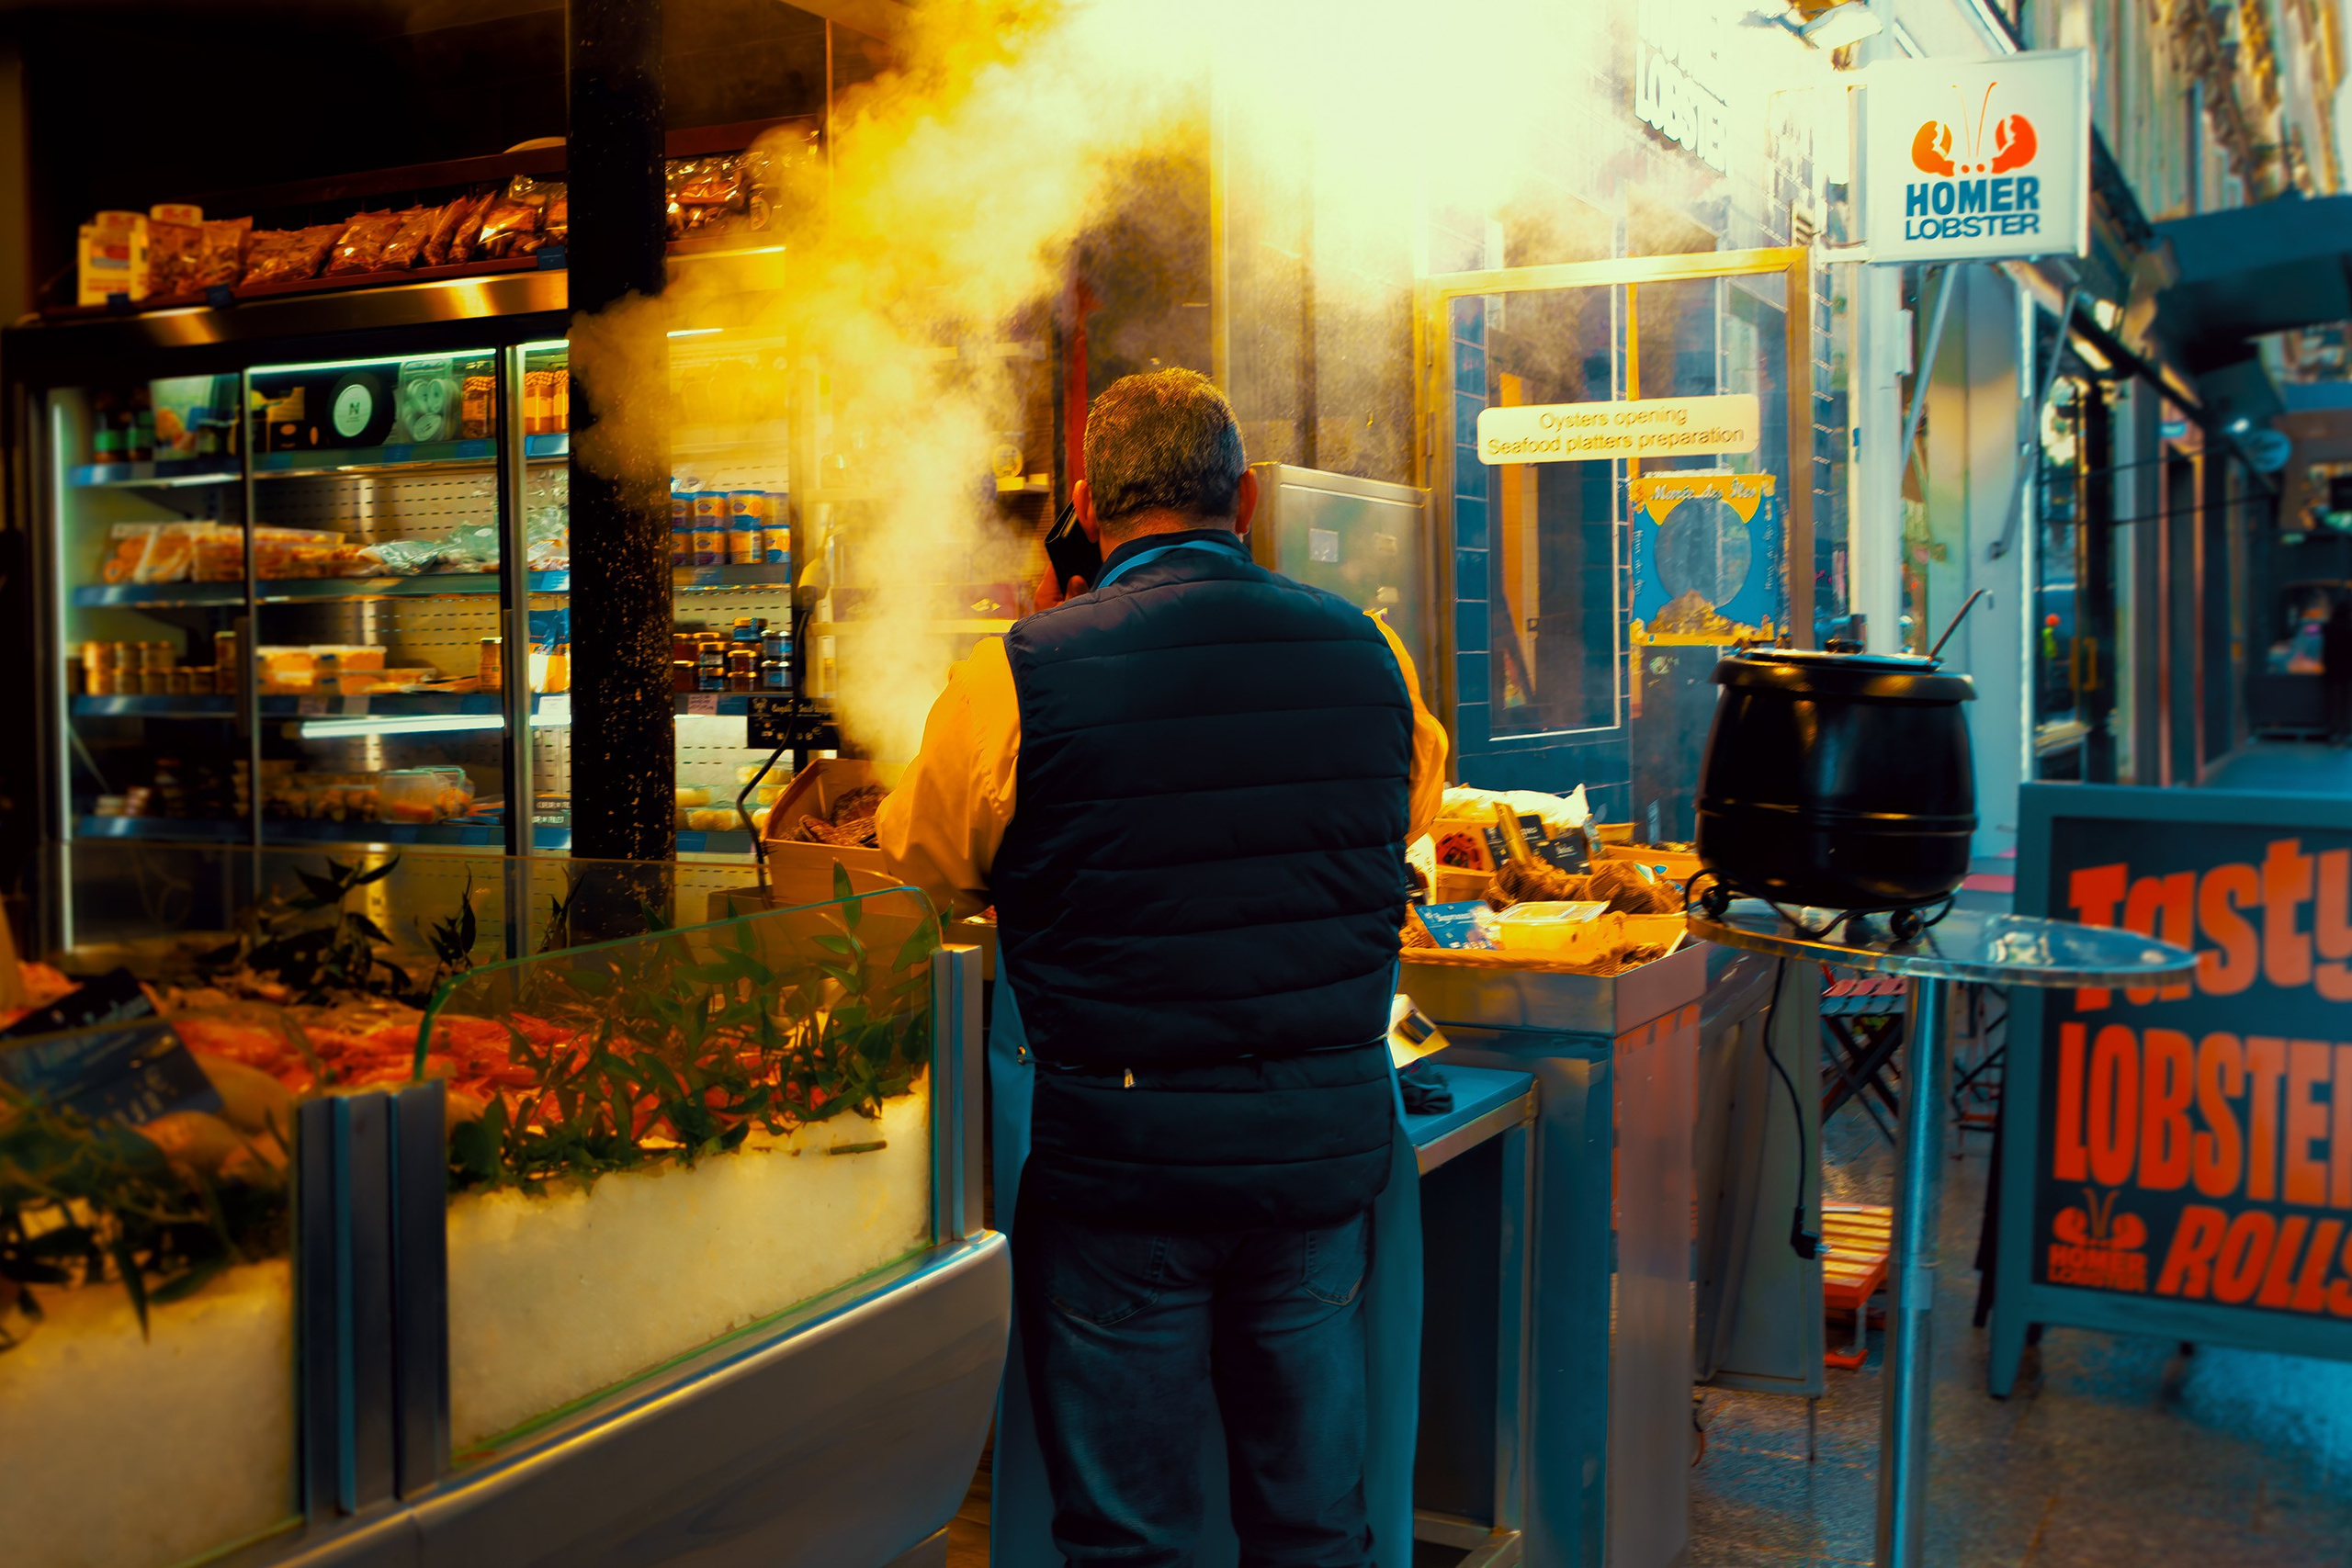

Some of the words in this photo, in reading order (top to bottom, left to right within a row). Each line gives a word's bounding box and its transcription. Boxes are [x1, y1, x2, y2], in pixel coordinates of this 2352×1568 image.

[1634, 40, 1730, 180] LOBSTE
[1905, 176, 2041, 217] HOMER
[1905, 213, 2041, 241] LOBSTER
[1539, 412, 1610, 433] Oysters
[1613, 405, 1688, 428] opening
[1487, 436, 1560, 456] Seafood
[1565, 432, 1634, 455] platters
[1637, 425, 1745, 451] preparation
